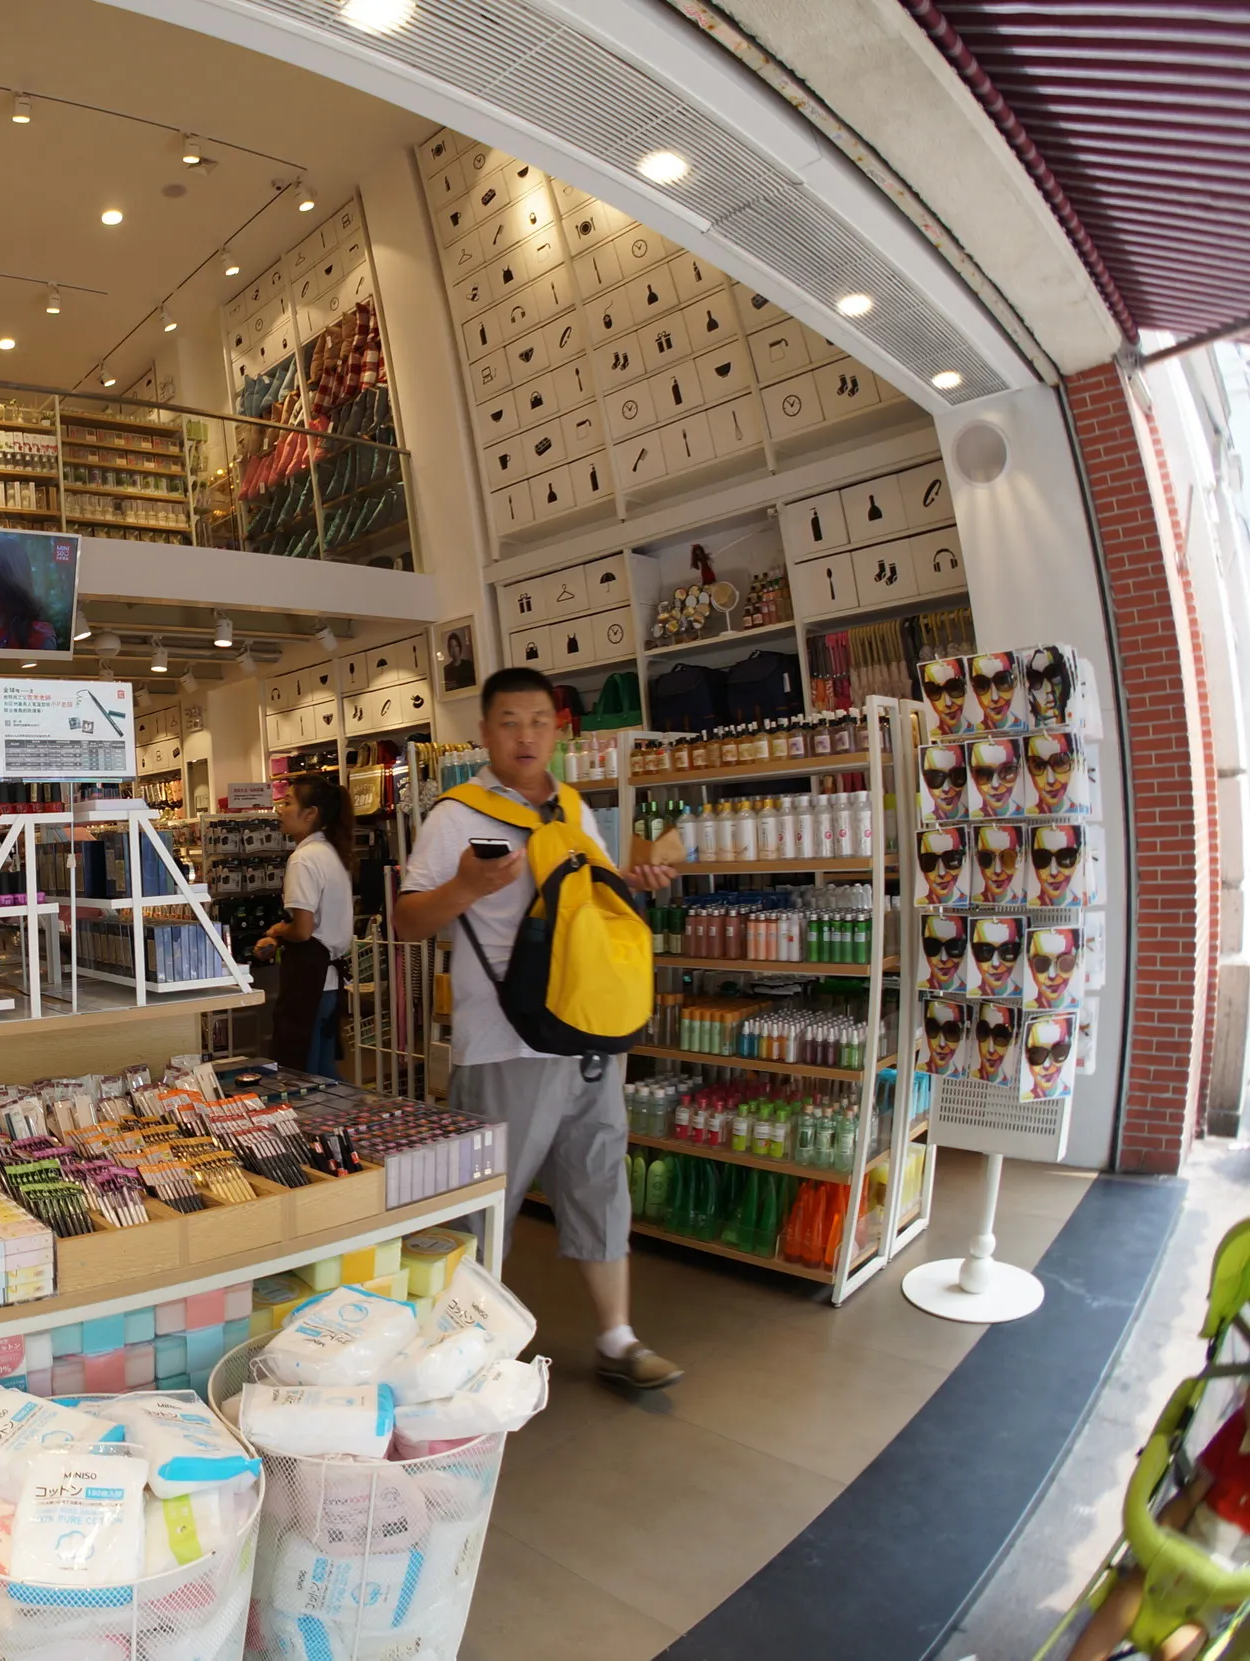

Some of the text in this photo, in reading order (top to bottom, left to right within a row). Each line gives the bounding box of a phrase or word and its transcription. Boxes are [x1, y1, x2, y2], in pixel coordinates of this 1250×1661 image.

[35, 1485, 83, 1498] コットン
[58, 1515, 83, 1525] PURE
